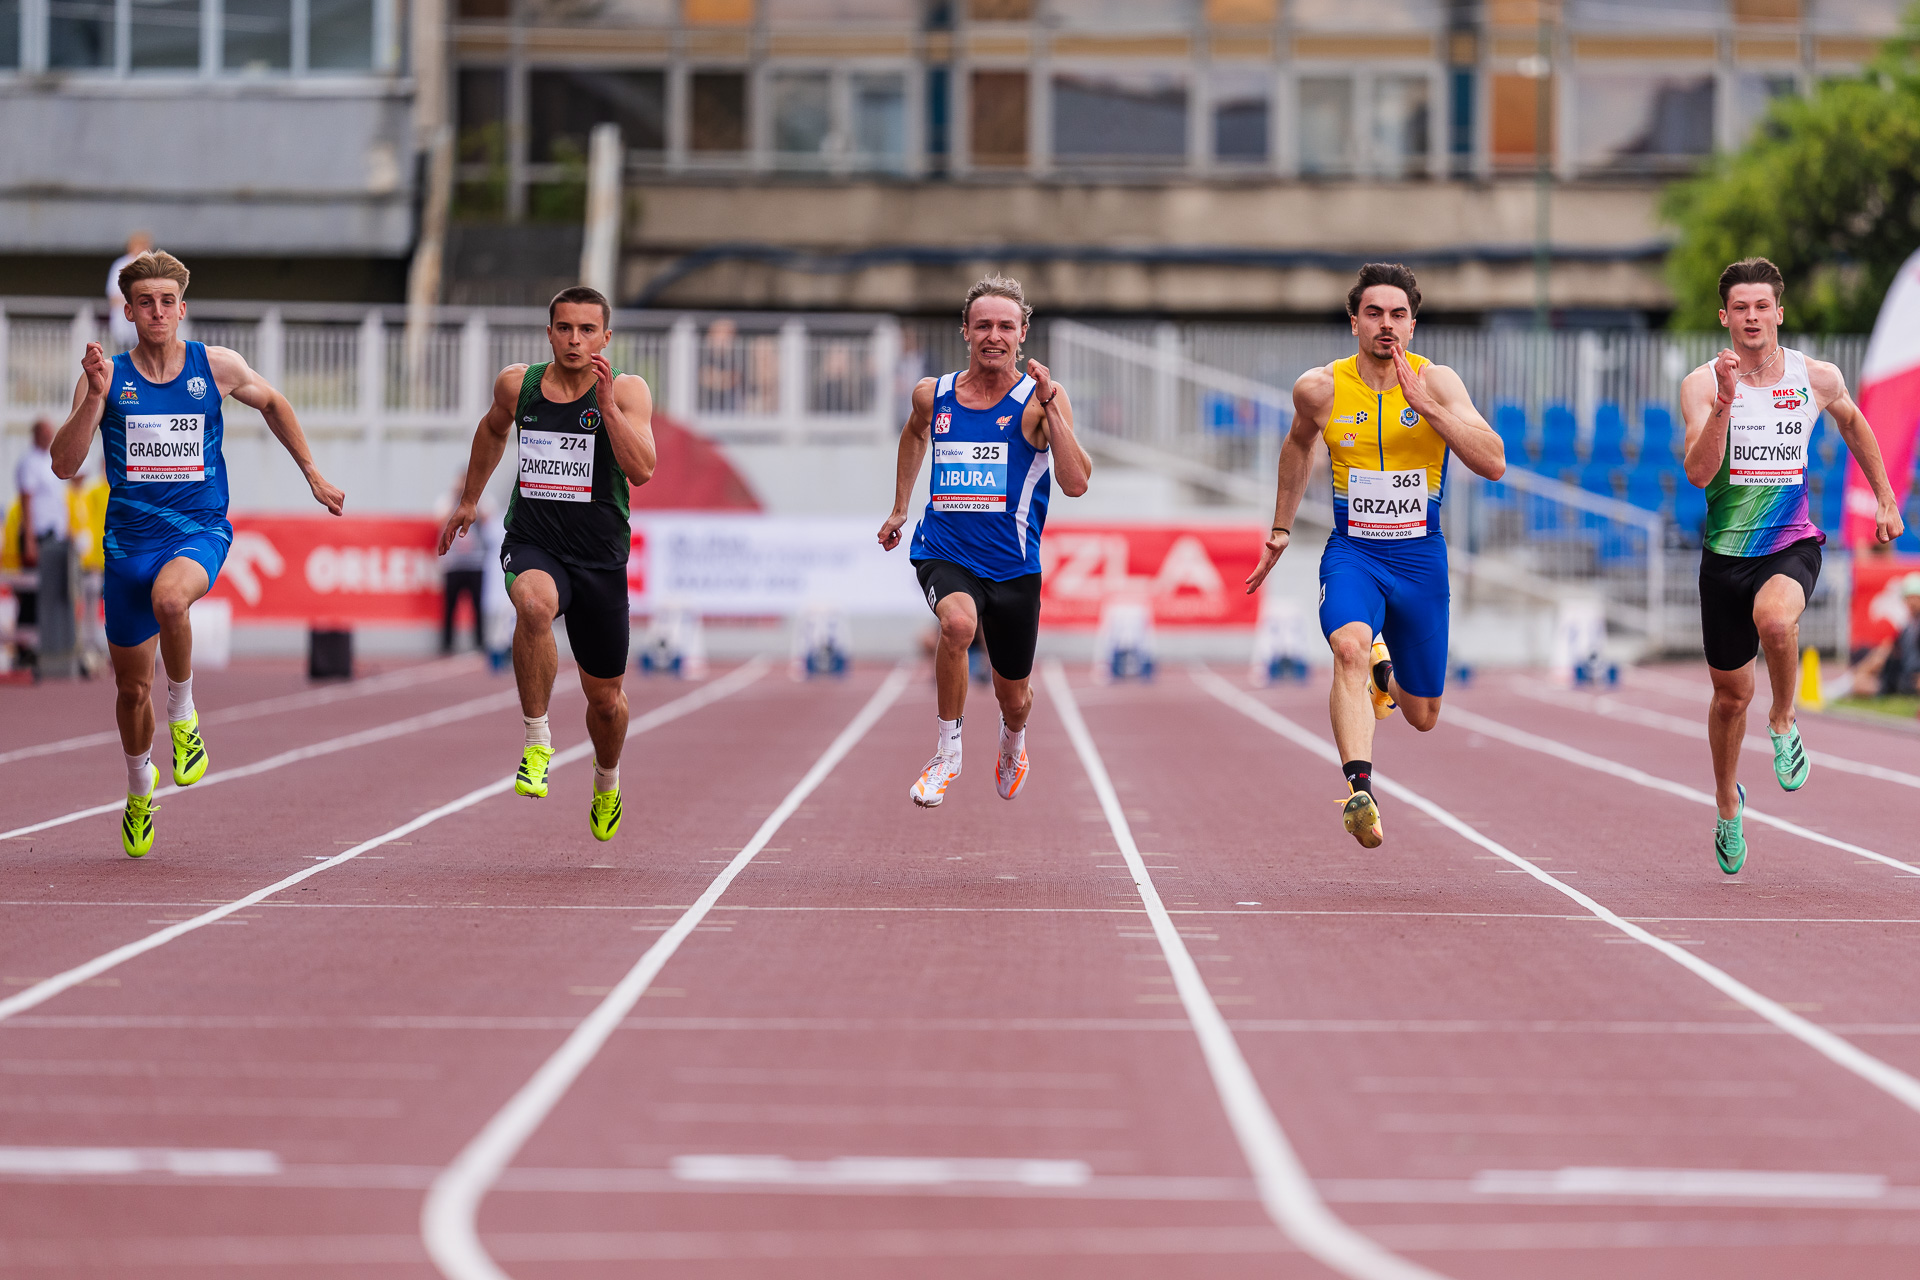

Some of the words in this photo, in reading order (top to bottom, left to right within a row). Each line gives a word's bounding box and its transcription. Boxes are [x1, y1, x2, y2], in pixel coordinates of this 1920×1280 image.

[1772, 388, 1795, 397] MKS
[170, 418, 198, 431] 283
[1776, 422, 1802, 435] 168
[529, 437, 552, 445] Kraków
[559, 437, 587, 451] 274
[129, 442, 200, 457] GRABOWSKI
[972, 446, 1000, 460] 325
[1734, 443, 1802, 461] BUCZYŃSKI
[521, 458, 590, 478] ZAKRZEWSKI
[940, 470, 996, 487] LIBURA
[1392, 473, 1421, 488] 363
[530, 490, 557, 498] KRAKÓW
[1352, 498, 1421, 517] GRZĄKA
